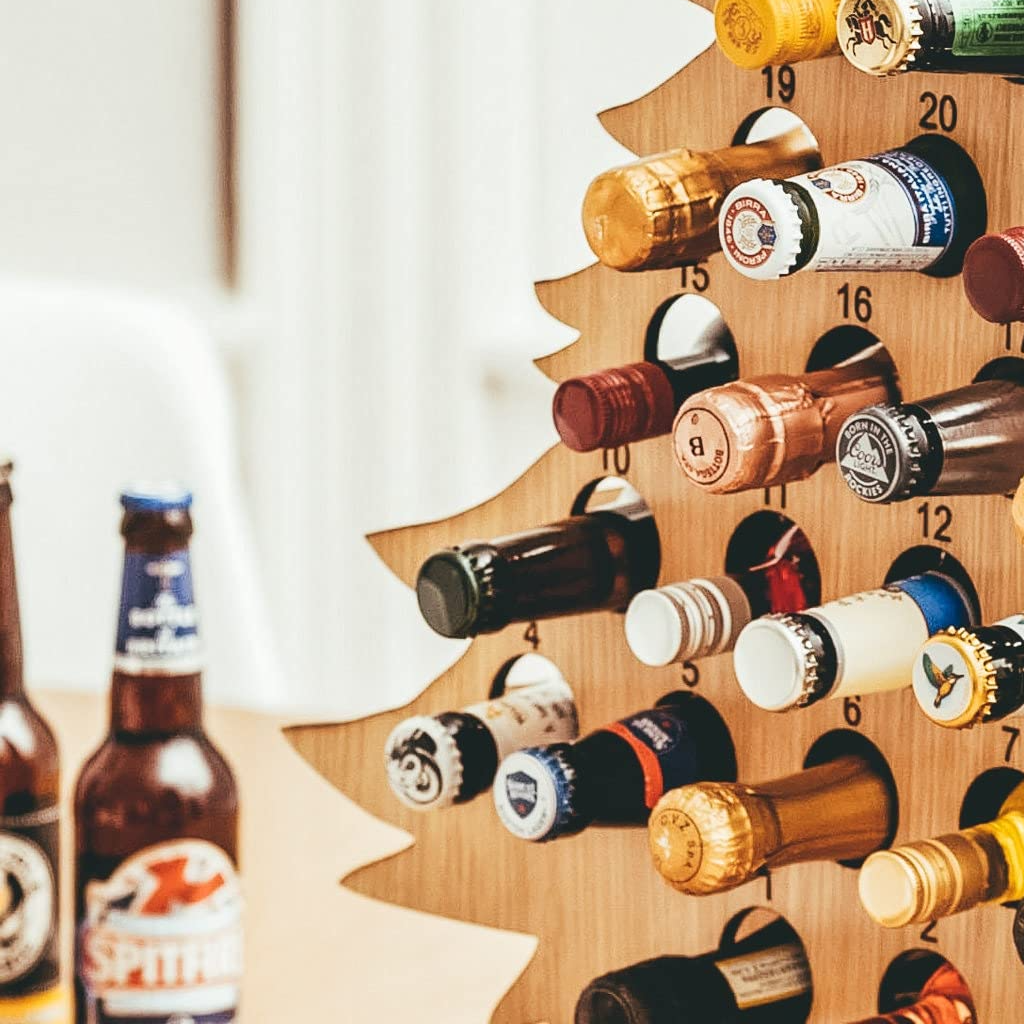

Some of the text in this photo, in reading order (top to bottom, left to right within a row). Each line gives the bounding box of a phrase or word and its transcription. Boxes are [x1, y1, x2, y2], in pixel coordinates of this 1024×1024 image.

[761, 64, 796, 104] 19
[918, 90, 958, 133] 20
[733, 199, 767, 265] BIRRA PERONI
[837, 282, 872, 323] 16
[689, 436, 705, 456] B
[844, 421, 894, 455] BORN IN THE
[849, 441, 883, 468] Coors
[853, 459, 877, 472] LIGHT
[844, 473, 883, 497] ROCKIES
[916, 501, 953, 542] 12
[524, 620, 540, 650] 4
[844, 695, 862, 727] 6
[1002, 725, 1021, 762] 7
[86, 930, 241, 989] SPITF
